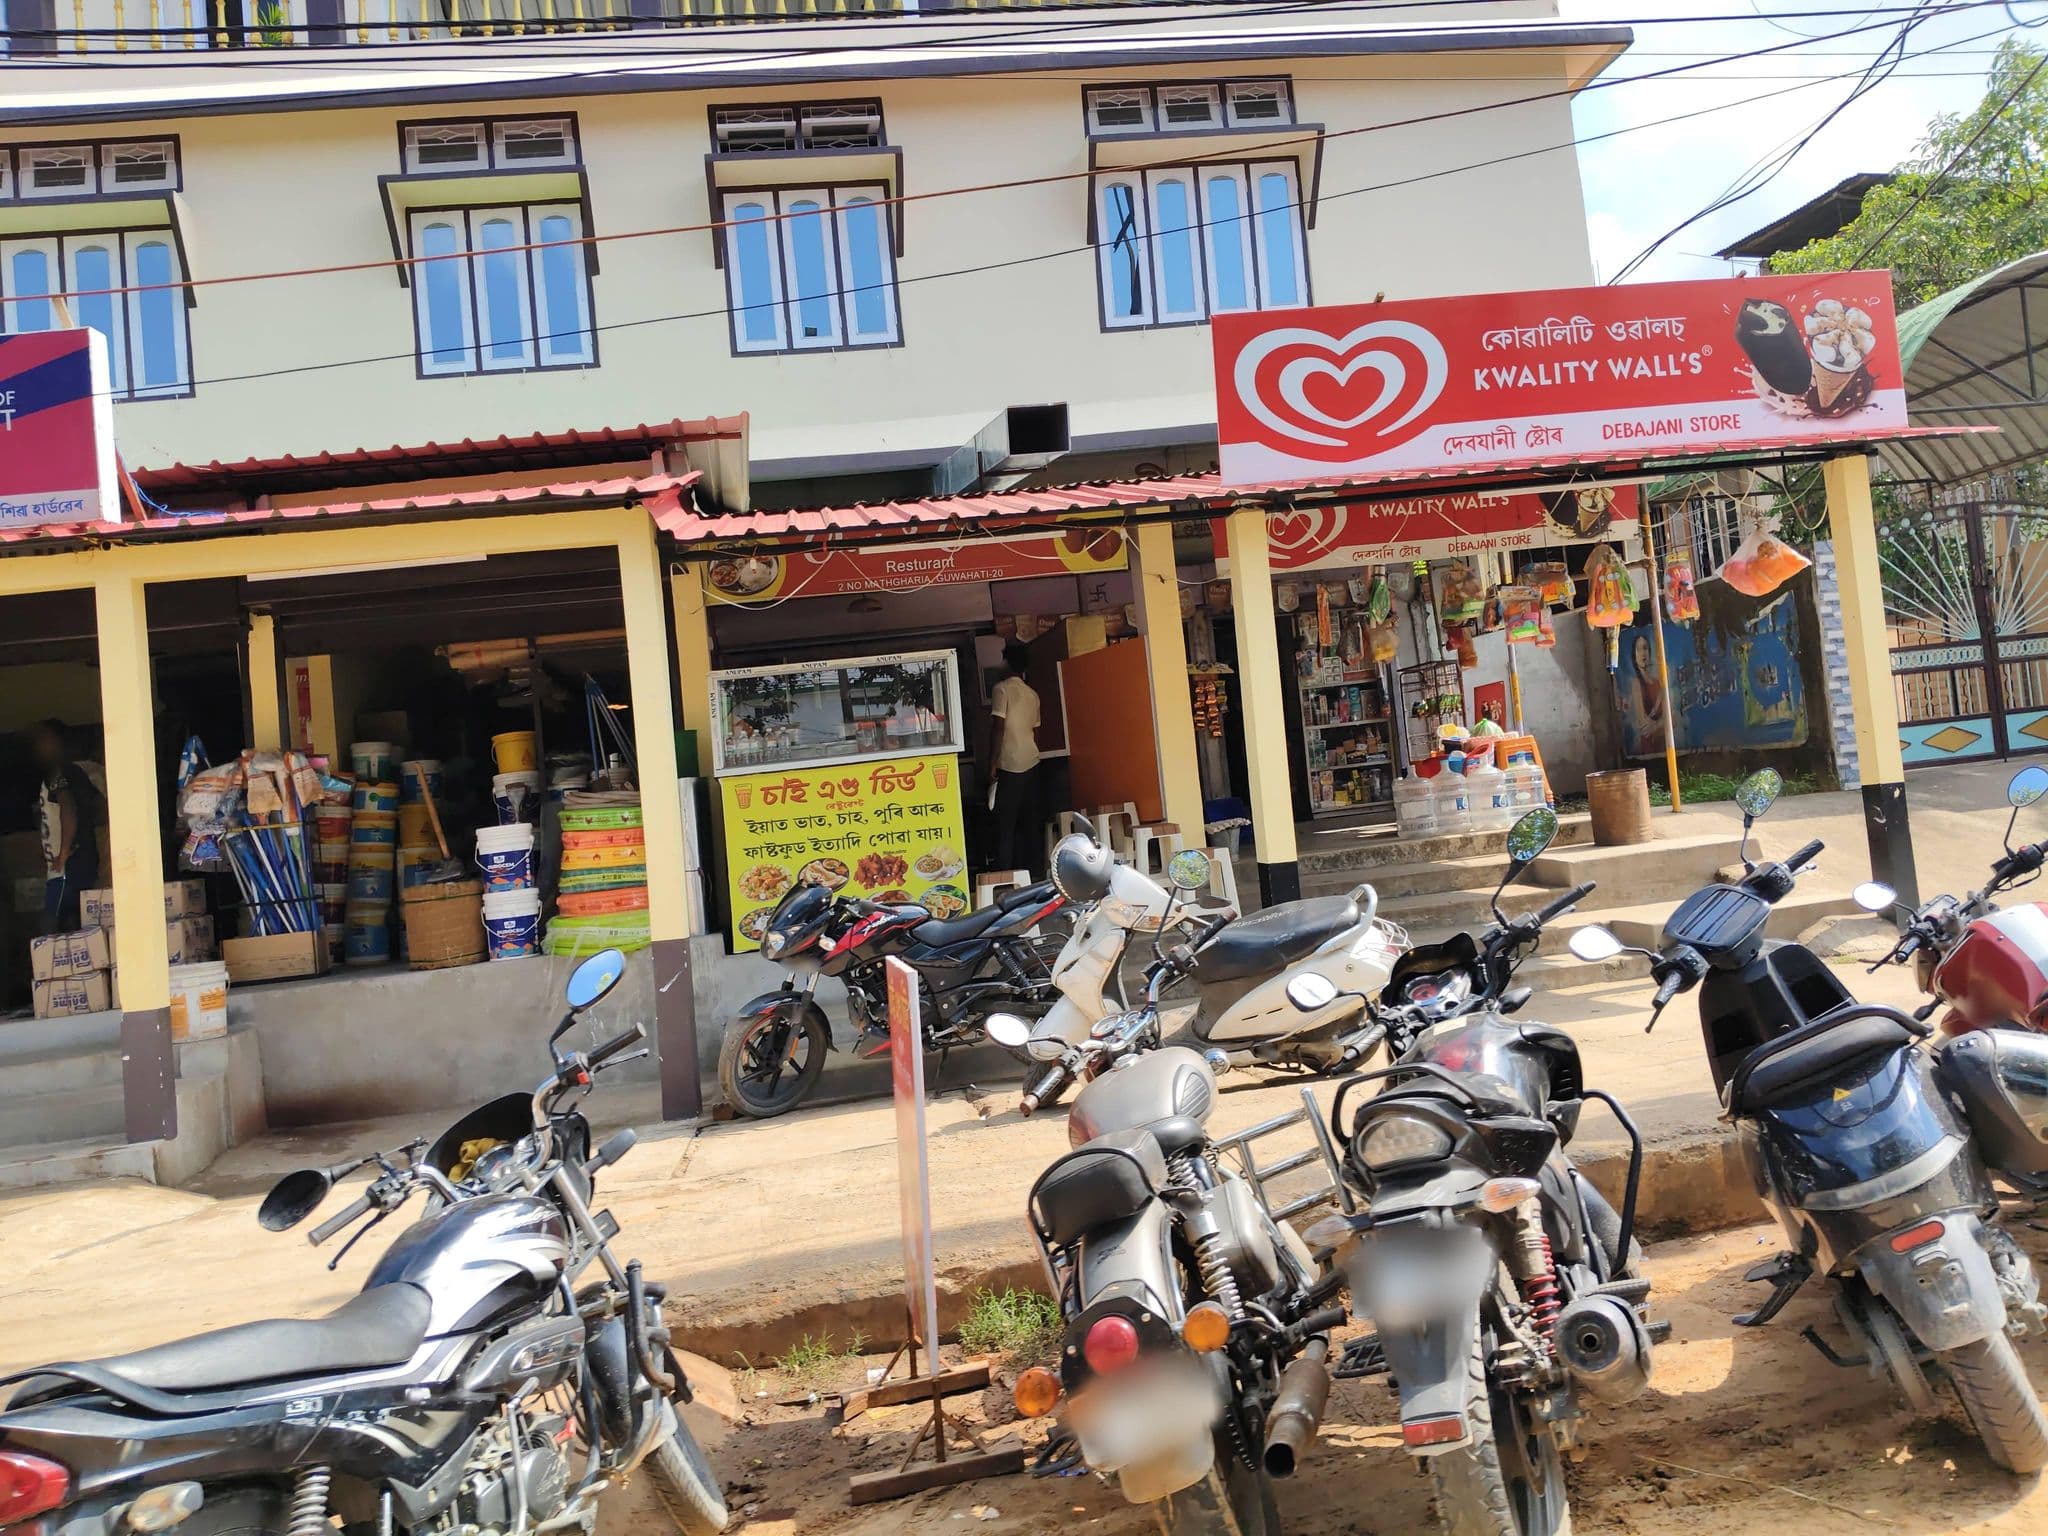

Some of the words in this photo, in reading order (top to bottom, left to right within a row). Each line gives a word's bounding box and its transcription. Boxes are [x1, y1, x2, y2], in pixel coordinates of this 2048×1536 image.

[1474, 359, 1600, 391] KWALITY
[1607, 352, 1703, 380] WALL'S
[1602, 418, 1683, 440] DEBAJANI
[1690, 412, 1741, 433] STORE
[1444, 425, 1517, 455] দেবযানী
[1369, 499, 1446, 519] KWALITY
[1451, 495, 1510, 511] WALLS
[1448, 538, 1497, 553] DEBAJANI
[1501, 534, 1532, 547] STORE
[886, 556, 955, 573] Resturant
[838, 583, 844, 592] 2
[847, 581, 862, 590] NO
[936, 569, 1003, 582] GUWAHATI-20
[793, 814, 832, 829] ভাত,
[836, 810, 868, 825] চাহ,
